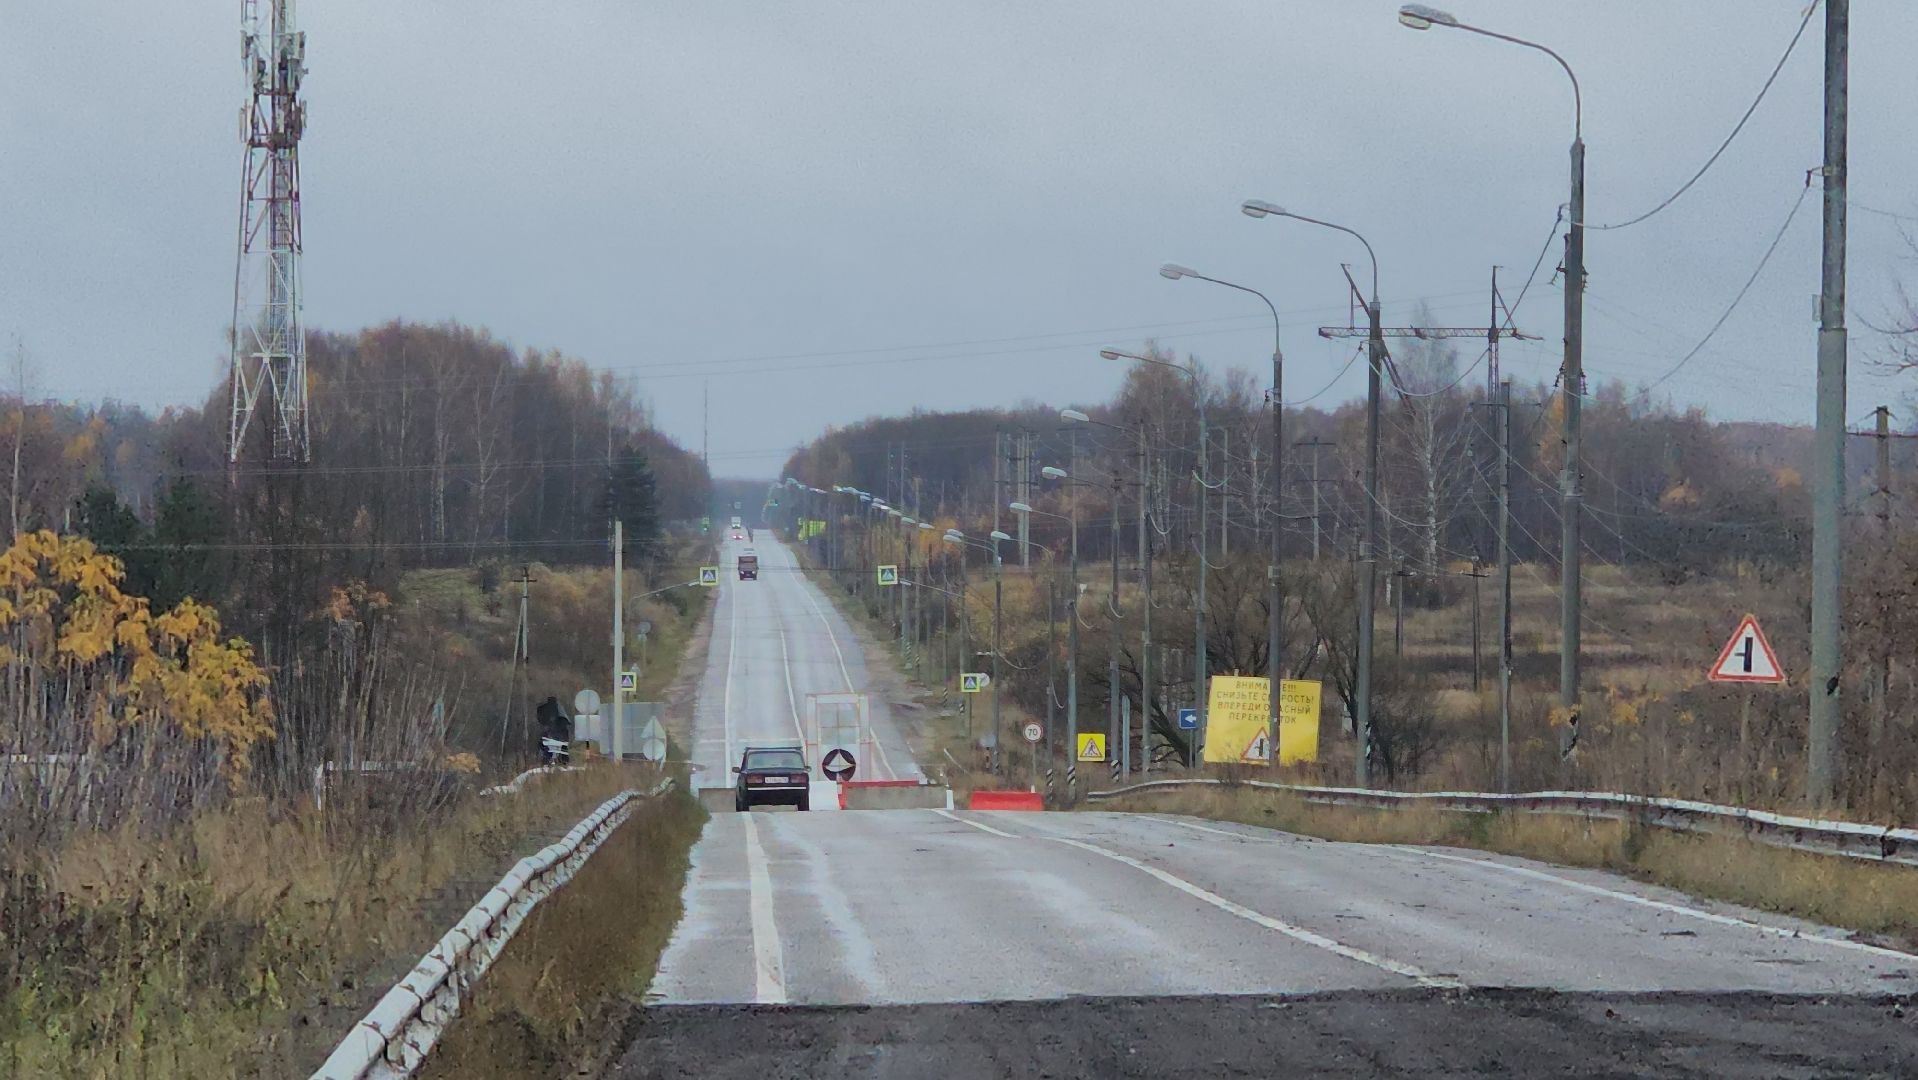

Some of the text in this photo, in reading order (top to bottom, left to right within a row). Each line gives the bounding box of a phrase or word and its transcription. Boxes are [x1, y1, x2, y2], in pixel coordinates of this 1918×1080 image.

[1236, 681, 1296, 692] ВНИМАЕ!!!
[1216, 692, 1314, 704] СНИЗЬТЕ СРОСТЬ!
[1217, 702, 1311, 714] ВПЕРЕДИ ОАСНЫЙ
[1027, 728, 1038, 737] 70
